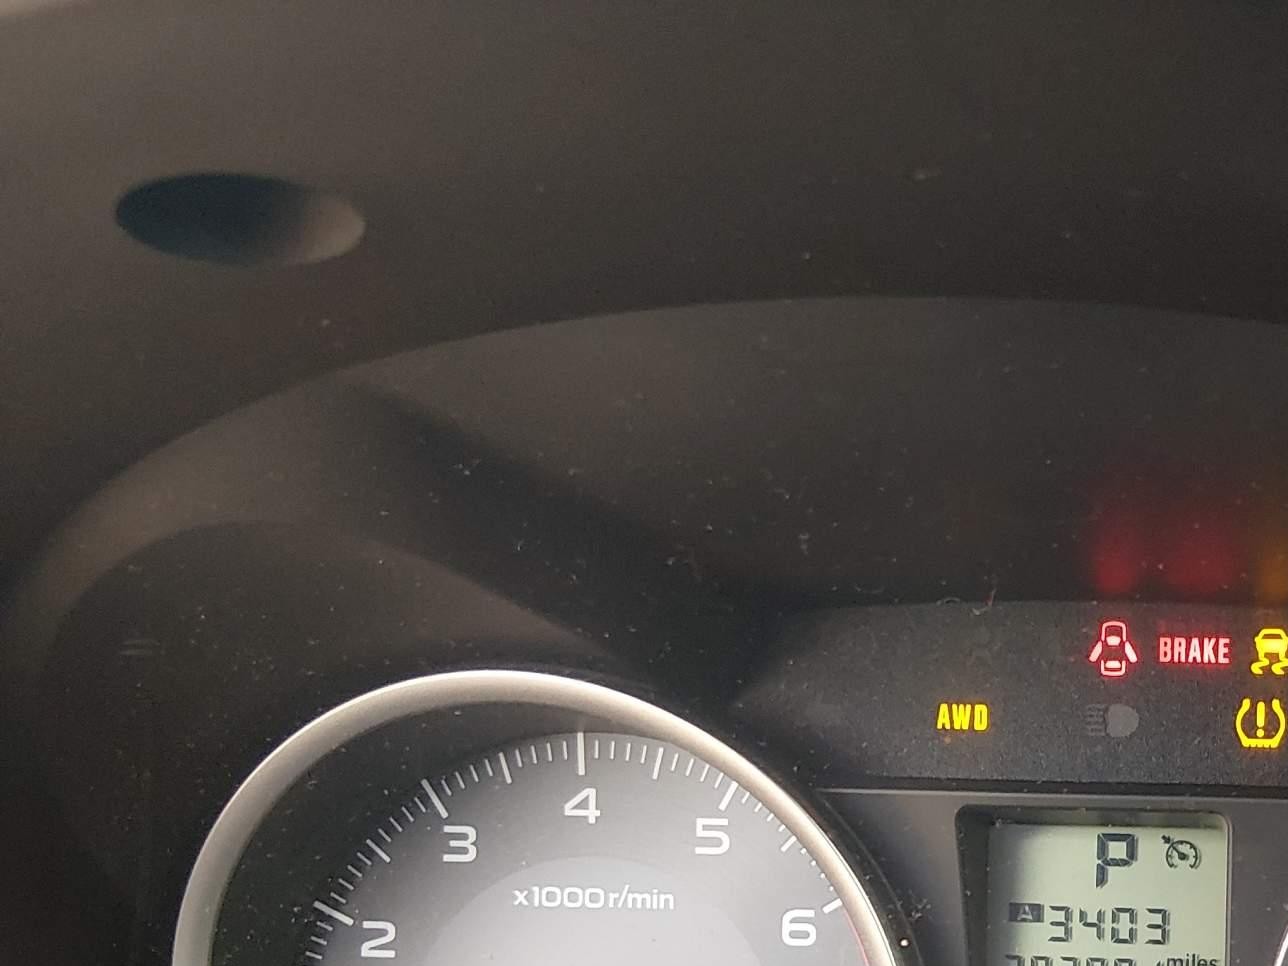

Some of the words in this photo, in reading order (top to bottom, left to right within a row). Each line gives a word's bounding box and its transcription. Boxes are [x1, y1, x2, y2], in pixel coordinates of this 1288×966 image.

[1159, 636, 1231, 667] BRAKE
[936, 703, 988, 731] AWD
[564, 787, 601, 824] 4
[442, 825, 477, 863] 3
[694, 817, 730, 855] 5
[1095, 832, 1139, 888] P
[360, 920, 396, 959] 2
[781, 909, 817, 947] 6
